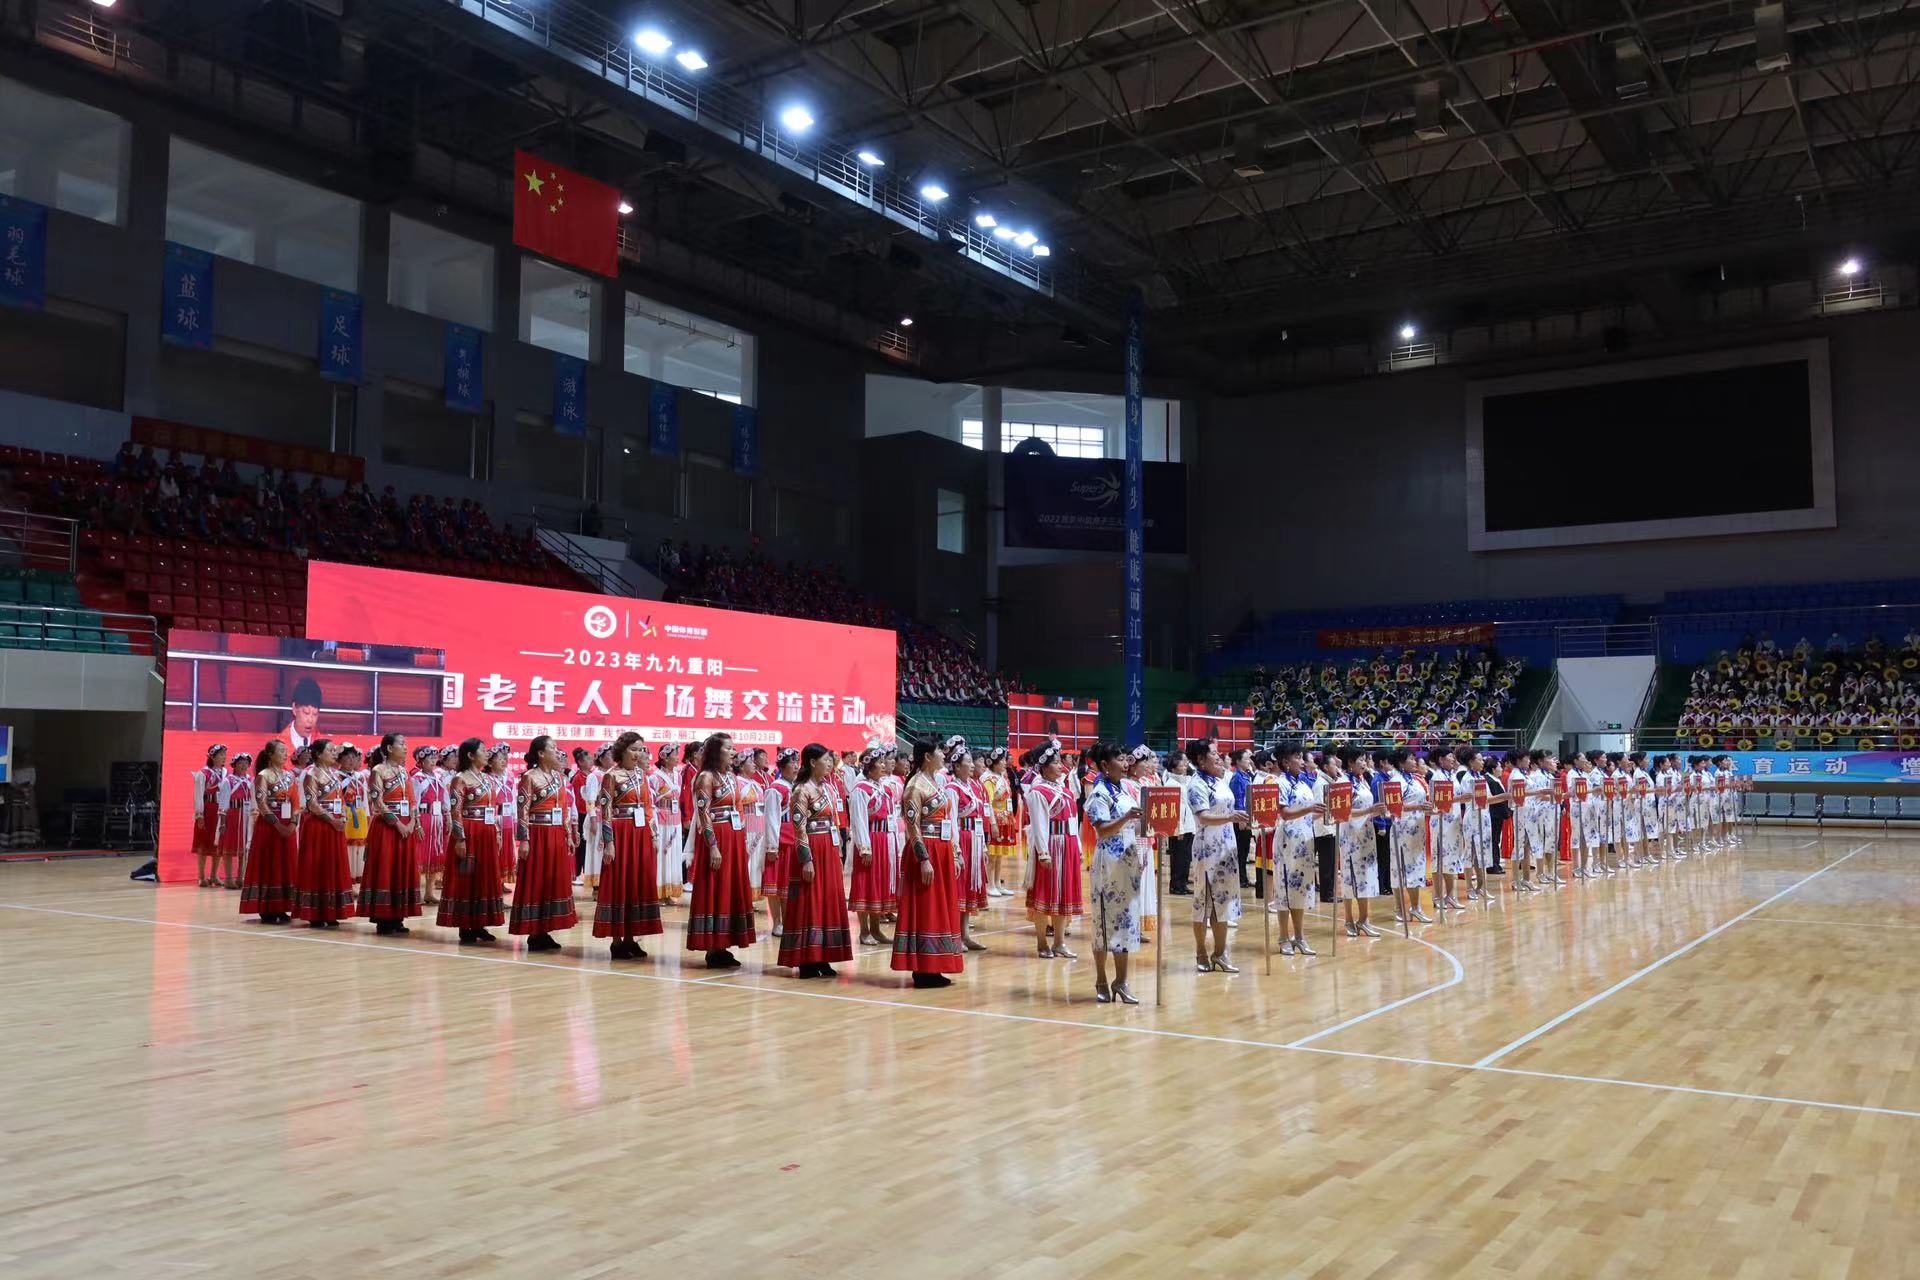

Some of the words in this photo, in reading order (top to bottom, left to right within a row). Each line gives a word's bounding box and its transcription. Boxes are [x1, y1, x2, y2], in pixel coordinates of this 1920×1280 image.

[4, 226, 26, 286] 羽毛球
[331, 315, 350, 367] 足球
[562, 376, 579, 421] 游泳
[563, 647, 724, 677] 2023年九九重阳
[507, 724, 549, 737] 我运动
[556, 725, 596, 738] 我健康
[1150, 801, 1177, 819] 永胜队
[1253, 797, 1278, 812] 玉龙二队
